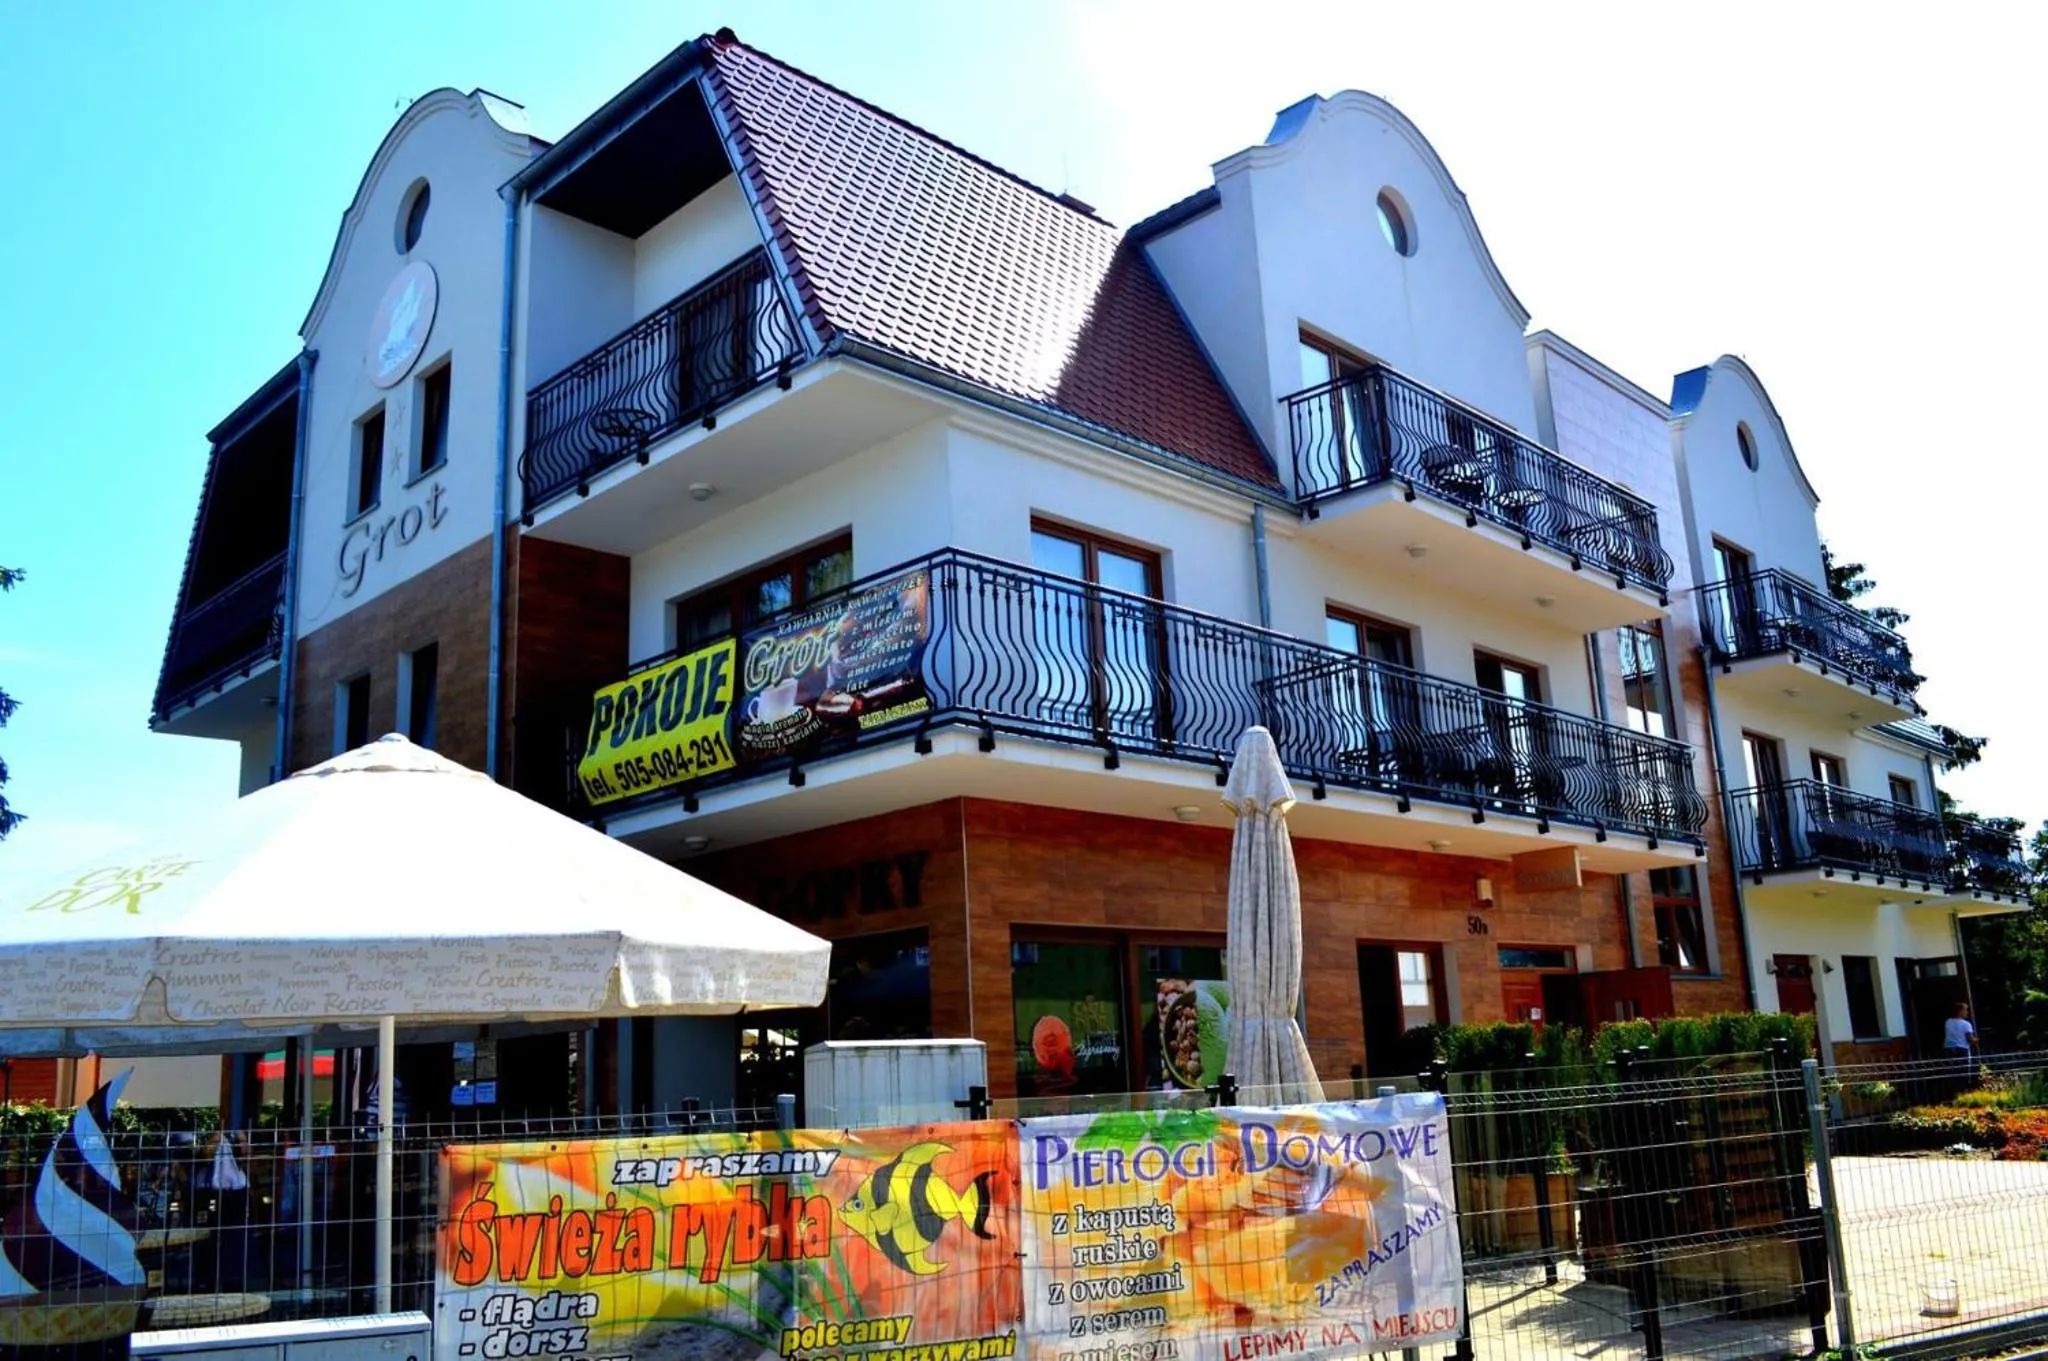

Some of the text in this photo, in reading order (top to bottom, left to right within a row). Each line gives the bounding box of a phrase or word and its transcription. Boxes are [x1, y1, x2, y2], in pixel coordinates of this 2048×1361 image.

[338, 482, 449, 600] Grot
[777, 604, 843, 637] KAWIARNIA
[744, 622, 842, 694] Grot
[588, 648, 731, 757] POKOJE
[581, 731, 730, 800] tel. 505-084-291
[612, 1149, 840, 1188] zapraszamy
[1035, 1121, 1439, 1190] PIEROGI DOMOWE
[453, 1181, 832, 1287] Świeża rybka
[1052, 1198, 1176, 1237] z kapustą
[1072, 1232, 1157, 1268] ruskie
[1314, 1201, 1442, 1308] ZAPRASZAMY
[1048, 1262, 1185, 1305] z owocami
[482, 1290, 599, 1329] flądra
[1069, 1306, 1168, 1338] z serem
[482, 1327, 589, 1359] dorsz
[780, 1314, 914, 1358] polecamy
[1223, 1307, 1458, 1361] LEPIMY NA MIEJSCU
